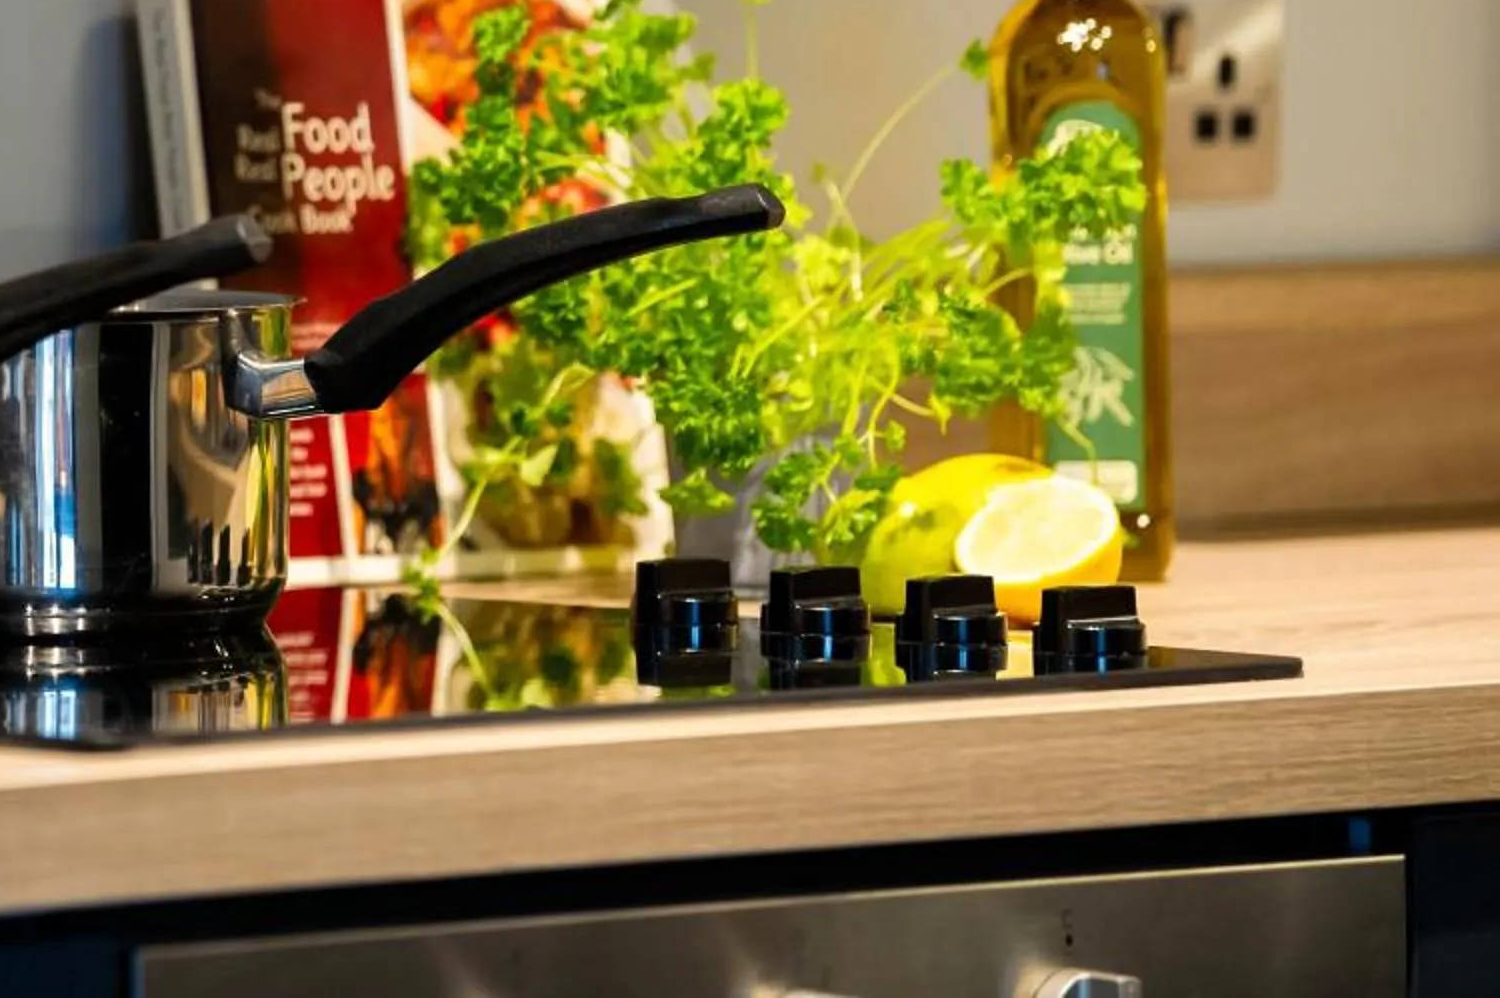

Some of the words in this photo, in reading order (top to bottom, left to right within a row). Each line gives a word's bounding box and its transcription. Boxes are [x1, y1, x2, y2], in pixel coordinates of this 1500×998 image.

[282, 100, 375, 153] Food
[281, 152, 396, 215] People
[299, 203, 355, 235] Book
